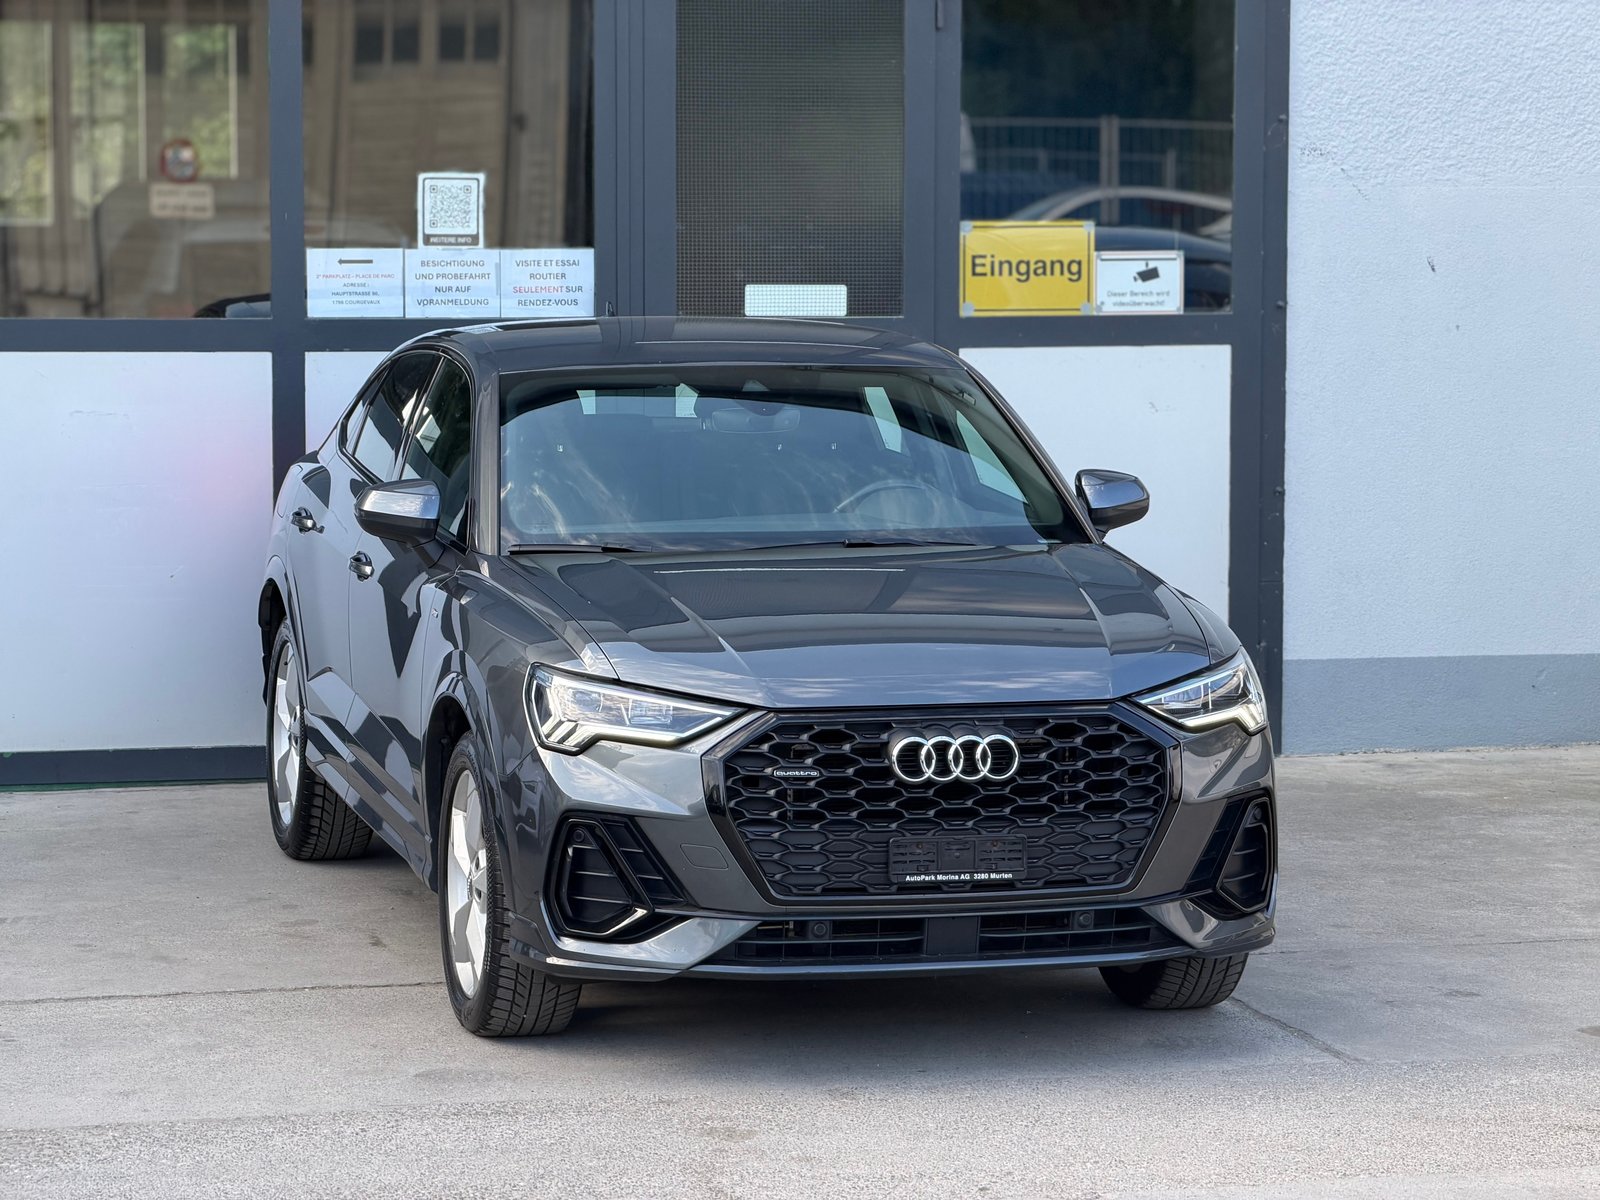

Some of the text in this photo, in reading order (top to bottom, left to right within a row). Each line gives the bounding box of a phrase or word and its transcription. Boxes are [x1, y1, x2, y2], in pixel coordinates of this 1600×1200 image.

[420, 260, 485, 268] BESICHTIGUNG
[556, 259, 580, 267] ESSAI
[971, 254, 1082, 283] Eingang
[529, 272, 567, 280] ROUTIER
[518, 298, 579, 306] RENDEZ-VOUS
